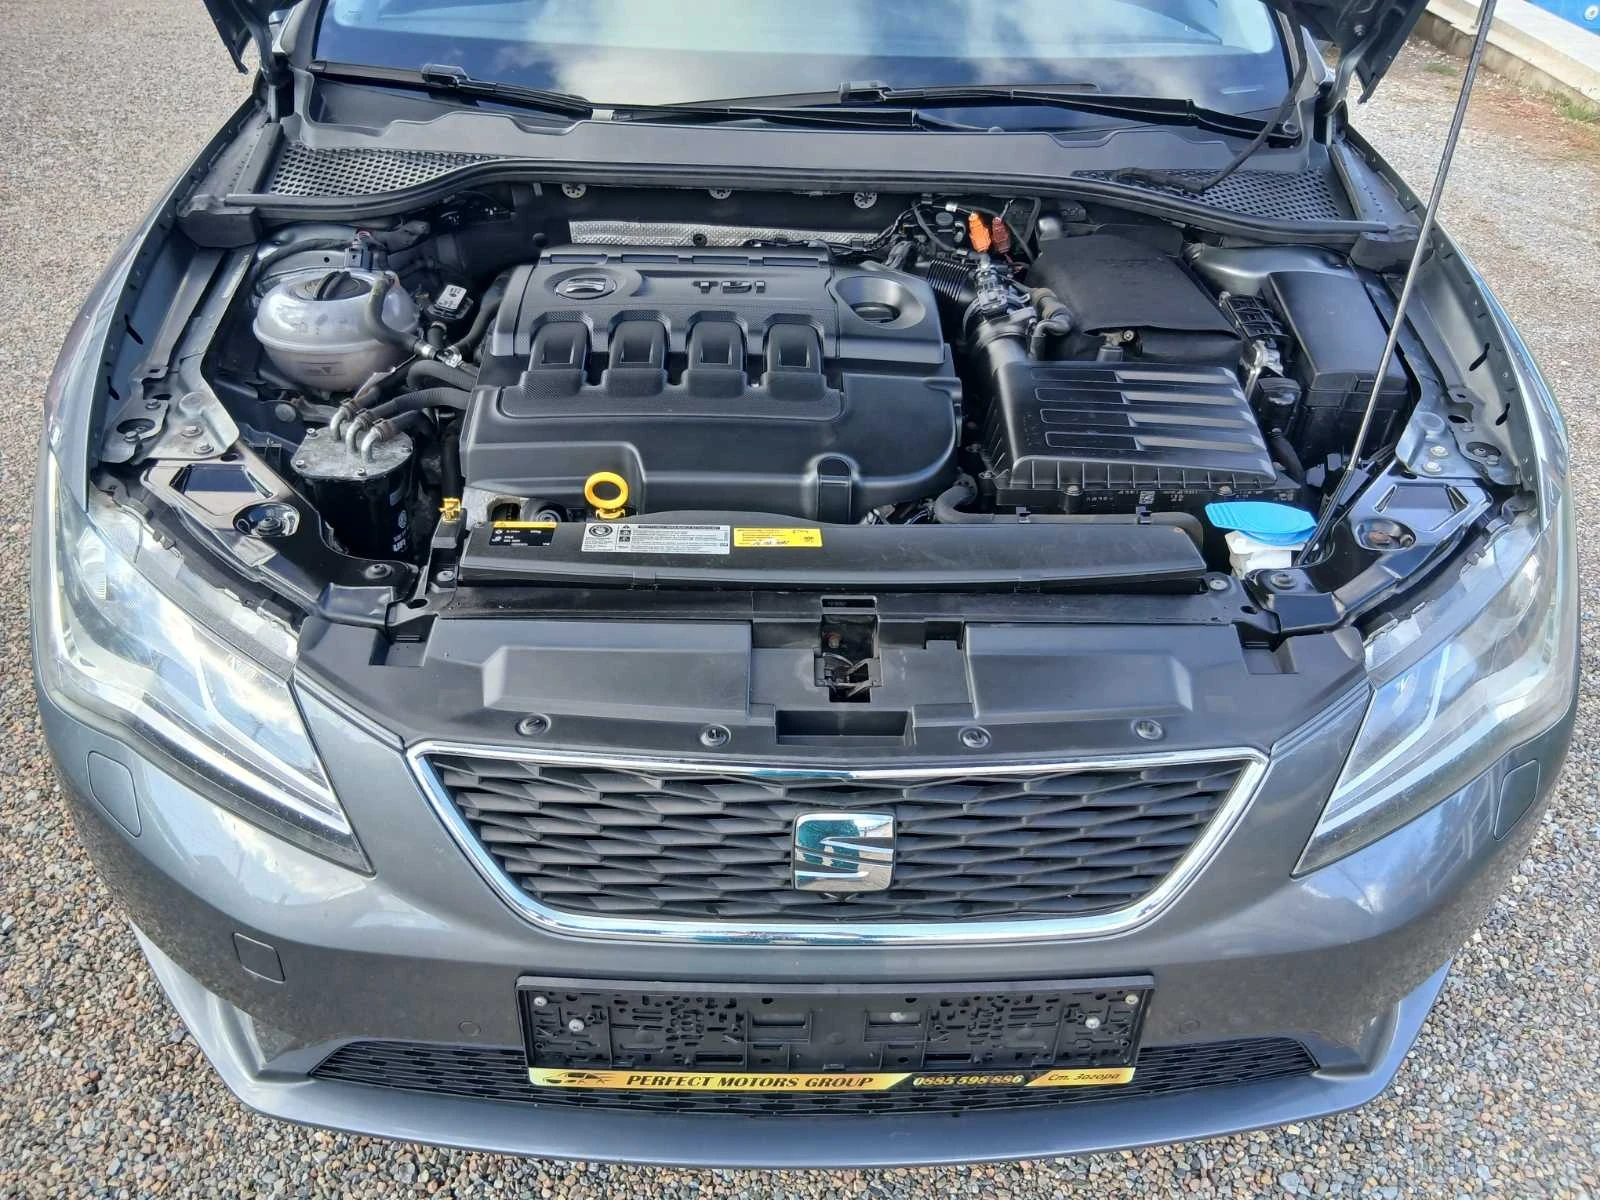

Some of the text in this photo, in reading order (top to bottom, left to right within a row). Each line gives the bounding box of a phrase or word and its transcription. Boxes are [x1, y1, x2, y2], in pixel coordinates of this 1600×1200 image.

[626, 1075, 873, 1088] PERFECT MOTORS GROUP
